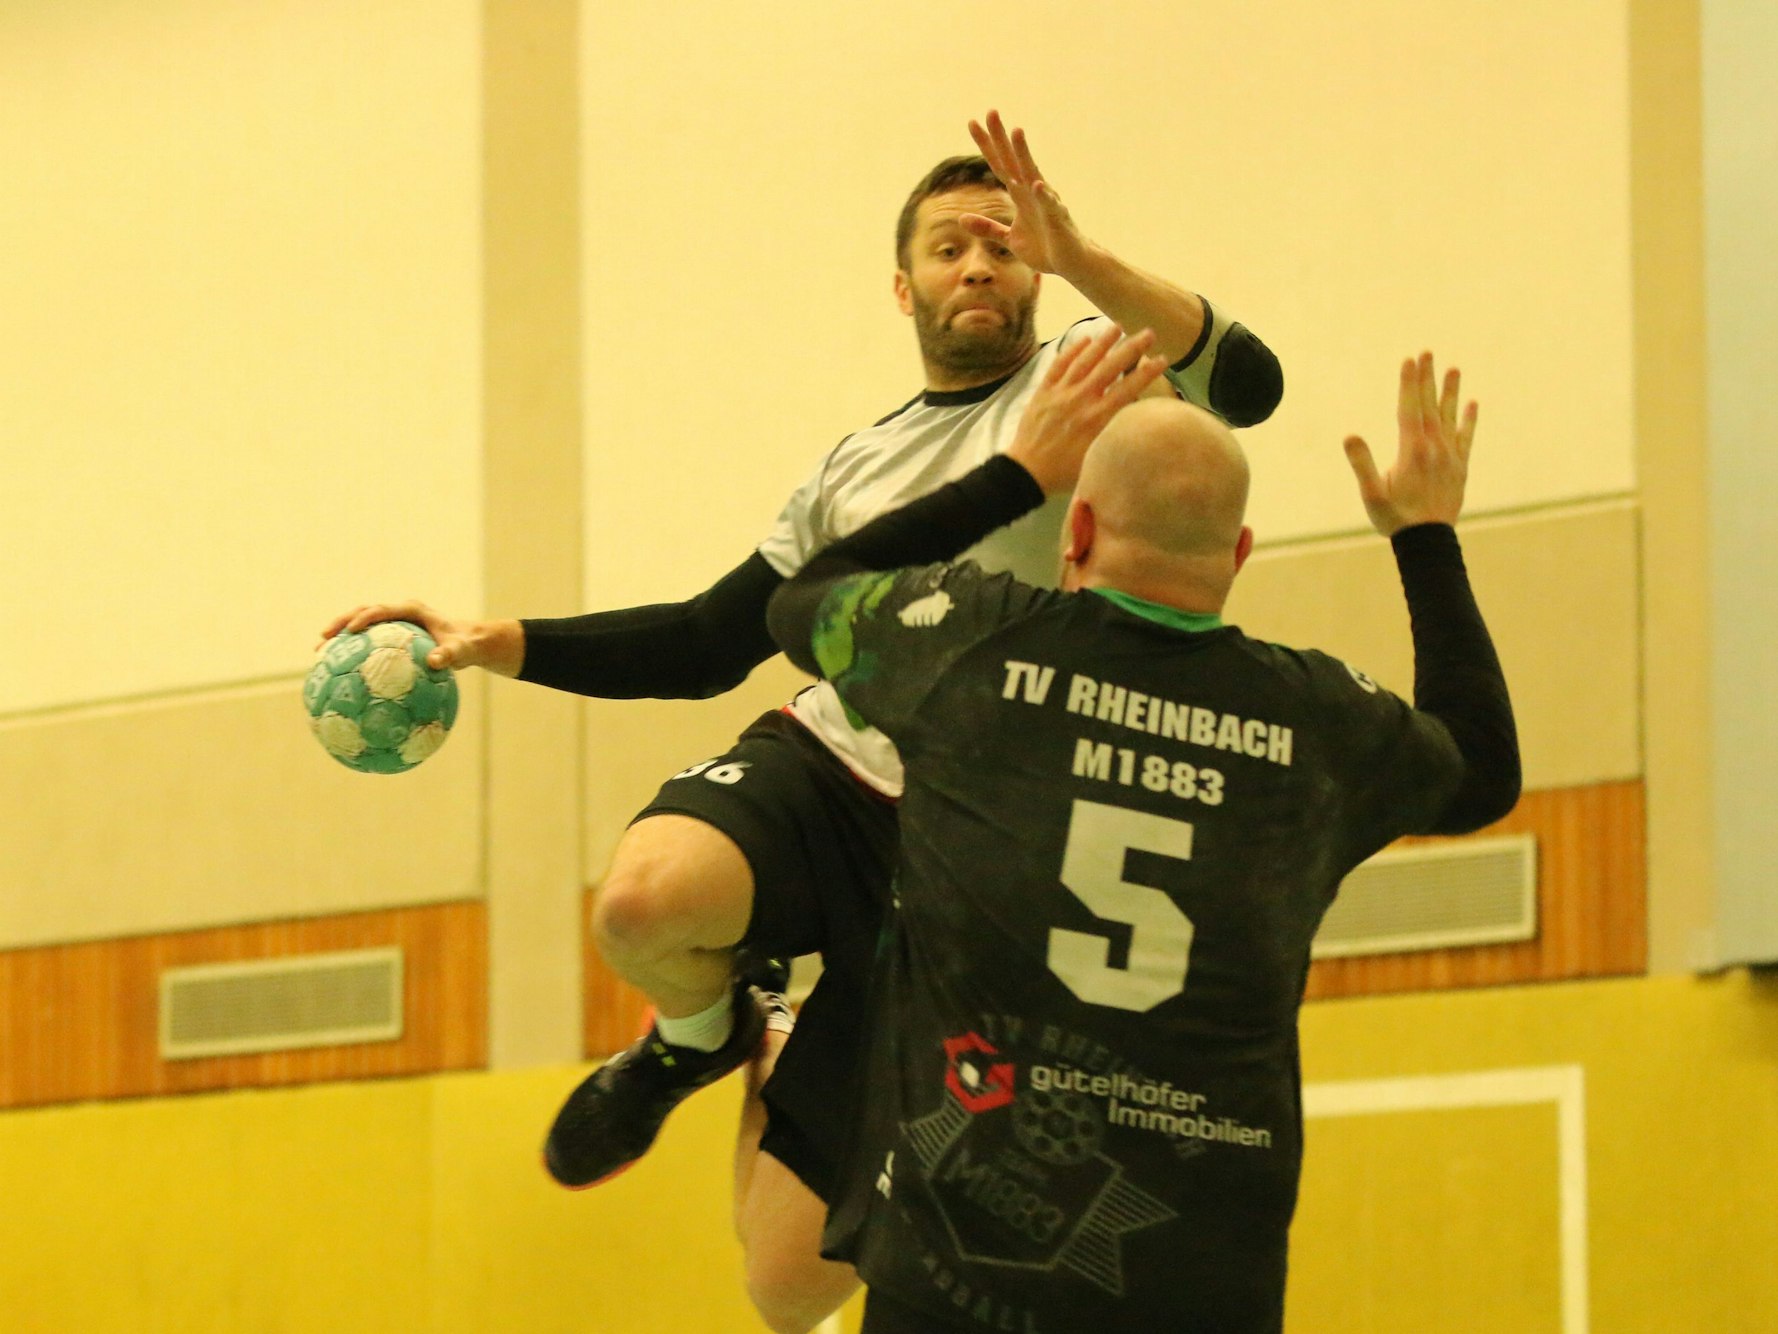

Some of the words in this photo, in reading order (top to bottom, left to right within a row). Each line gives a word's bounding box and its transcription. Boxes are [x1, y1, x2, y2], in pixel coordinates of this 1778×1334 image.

[1002, 660, 1056, 705] TV
[1066, 673, 1293, 767] RHEINBACH
[1072, 738, 1225, 806] M1883
[1046, 799, 1195, 1013] 5
[1030, 1062, 1207, 1112] gütelhöfer
[1108, 1098, 1272, 1149] Immobilien
